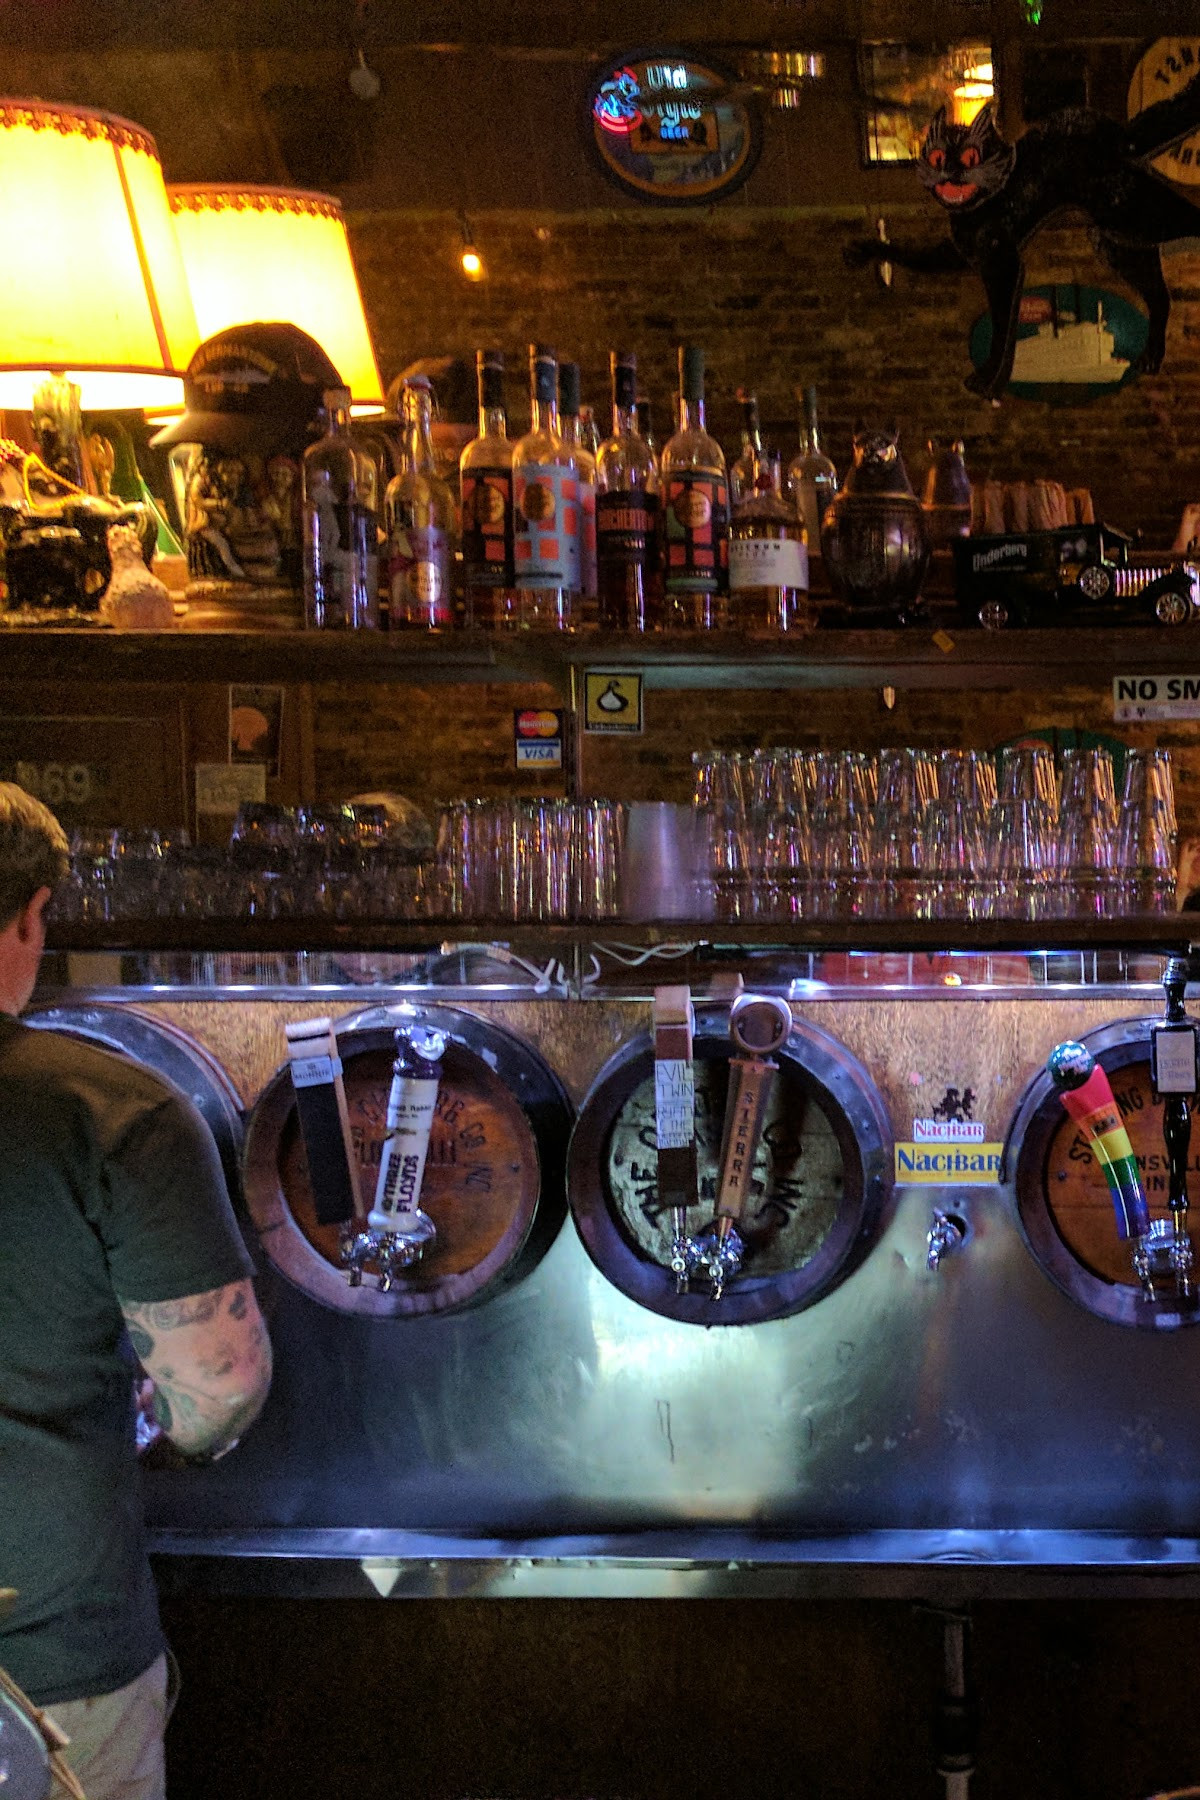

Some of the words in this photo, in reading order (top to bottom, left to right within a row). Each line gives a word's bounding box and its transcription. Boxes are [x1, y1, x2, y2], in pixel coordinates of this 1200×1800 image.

[1118, 679, 1158, 701] NO
[524, 748, 555, 760] VISA
[656, 1062, 686, 1083] EVIL
[659, 1083, 693, 1098] TWIN
[731, 1091, 756, 1187] SIERRA
[397, 1154, 420, 1214] FLOYDS
